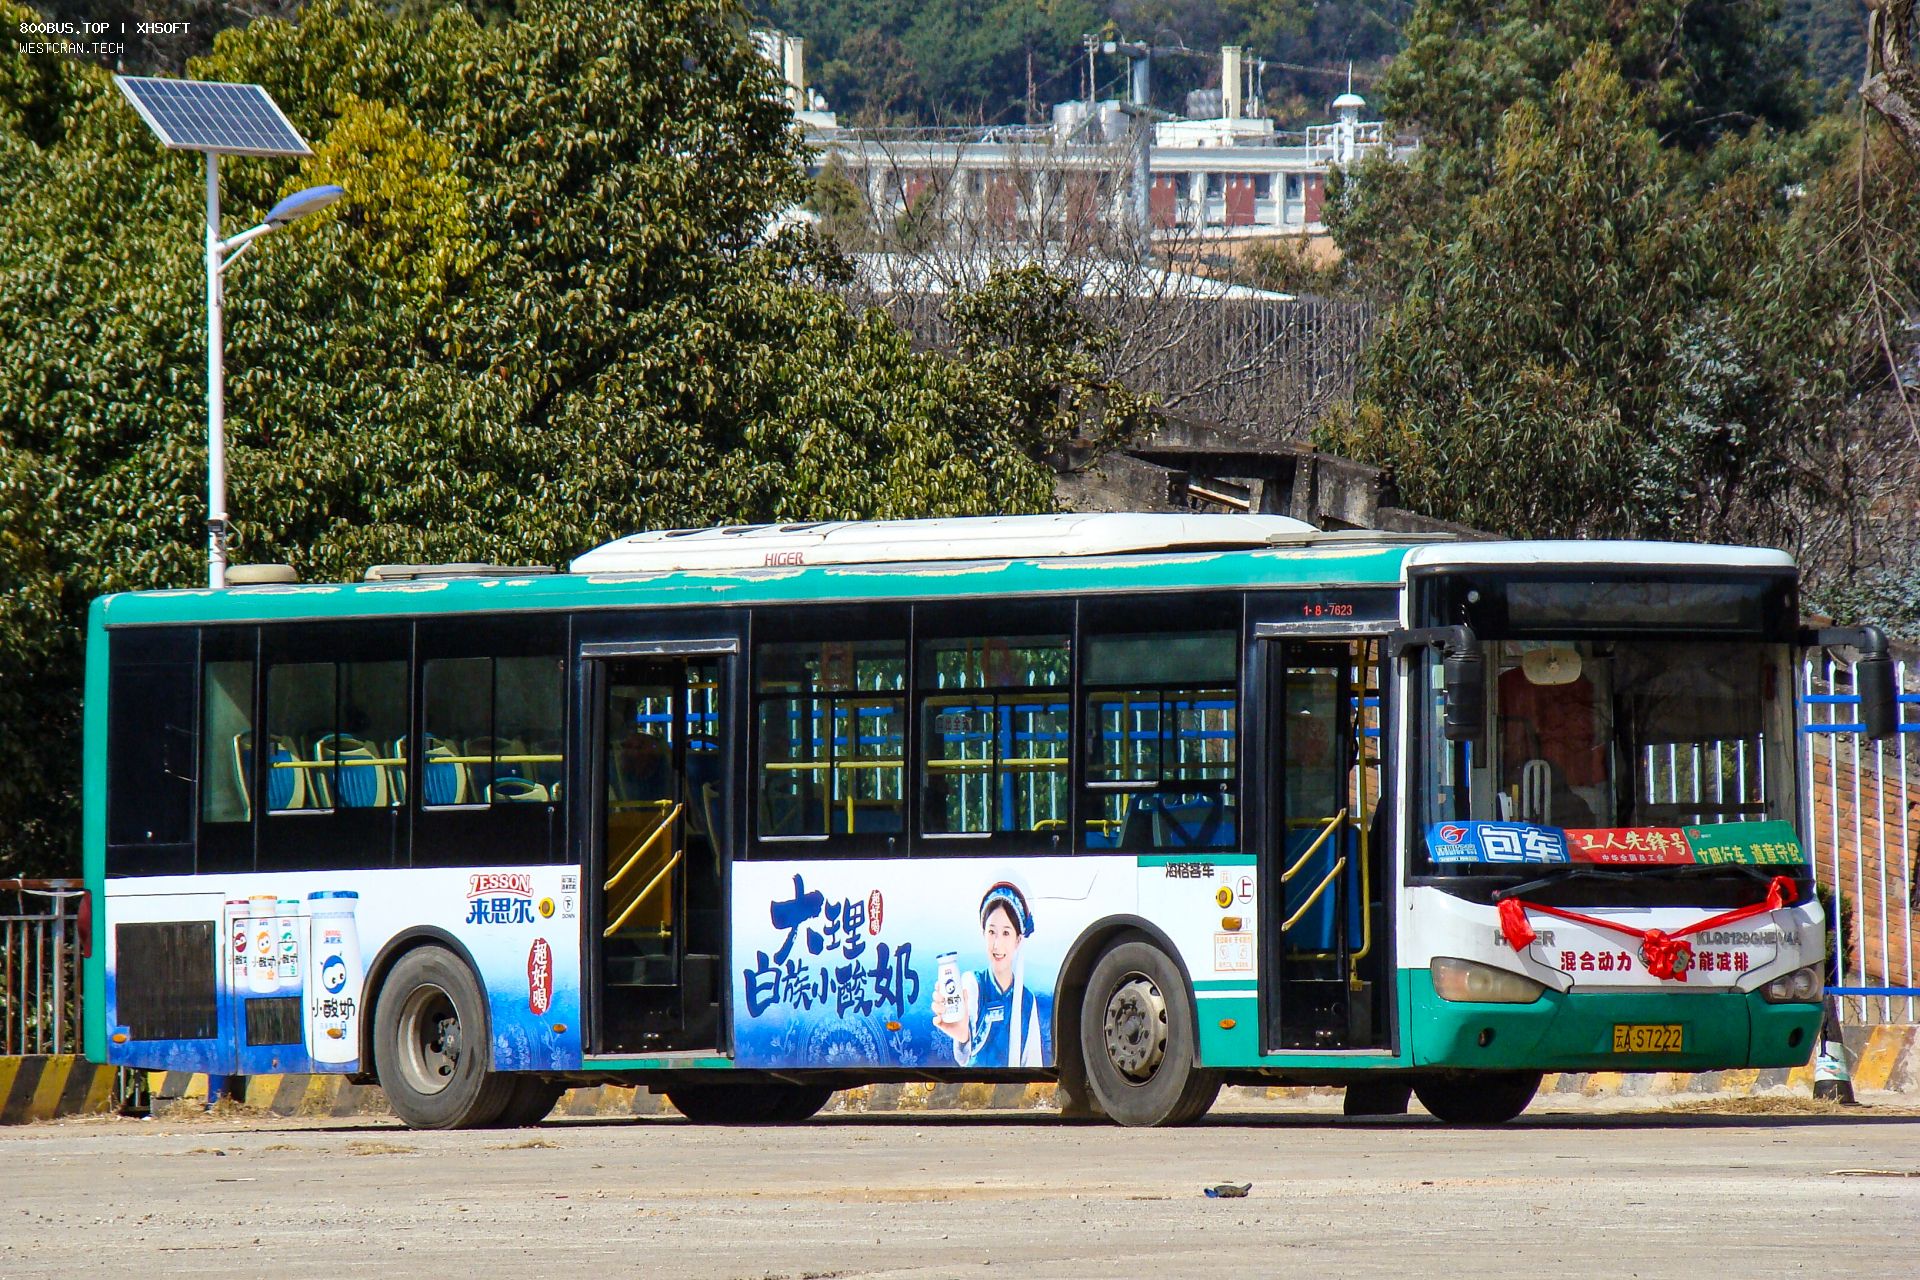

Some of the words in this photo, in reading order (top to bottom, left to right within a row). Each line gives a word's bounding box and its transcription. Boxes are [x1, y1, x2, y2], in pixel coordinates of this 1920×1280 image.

[764, 551, 804, 567] HIGER
[1477, 825, 1566, 863] 包车
[1581, 830, 1686, 856] 工人先锋号
[1697, 844, 1747, 865] 文明行车
[1750, 842, 1804, 865] 遵章守纪
[1602, 853, 1665, 862] 中华全国总工会
[1238, 879, 1252, 898] 上
[466, 897, 535, 925] 来思尔
[770, 873, 866, 967] 大理
[1494, 929, 1556, 947] HER
[1560, 951, 1633, 972] 混合动力
[531, 940, 549, 1014] 超好喝
[743, 942, 920, 1020] 白族小酸奶
[312, 997, 356, 1021] 小酸奶
